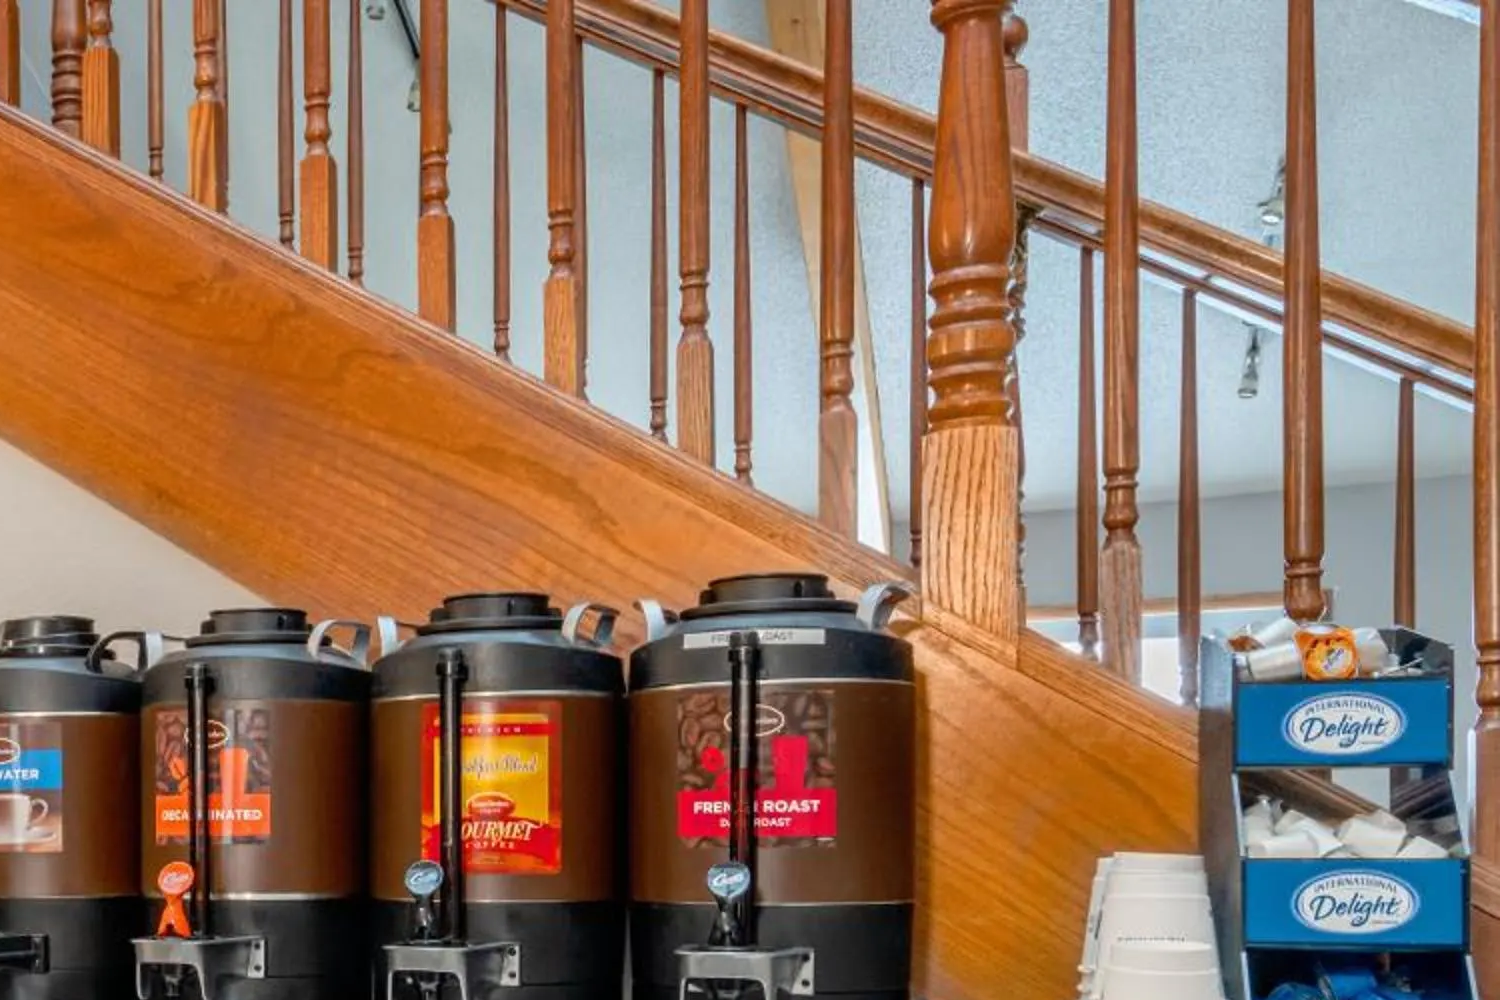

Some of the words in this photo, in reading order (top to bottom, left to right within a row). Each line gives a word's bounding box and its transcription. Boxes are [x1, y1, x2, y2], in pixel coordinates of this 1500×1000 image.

[1304, 699, 1385, 715] INTERNATIONAL
[1300, 713, 1389, 748] Delight
[693, 801, 758, 814] FREN
[763, 799, 820, 813] ROAST
[163, 809, 263, 821] DECAINATED
[754, 817, 792, 827] ROAST
[461, 821, 536, 841] OURMET
[1314, 877, 1397, 893] INTERNATIONAL
[1309, 892, 1402, 927] Delight
